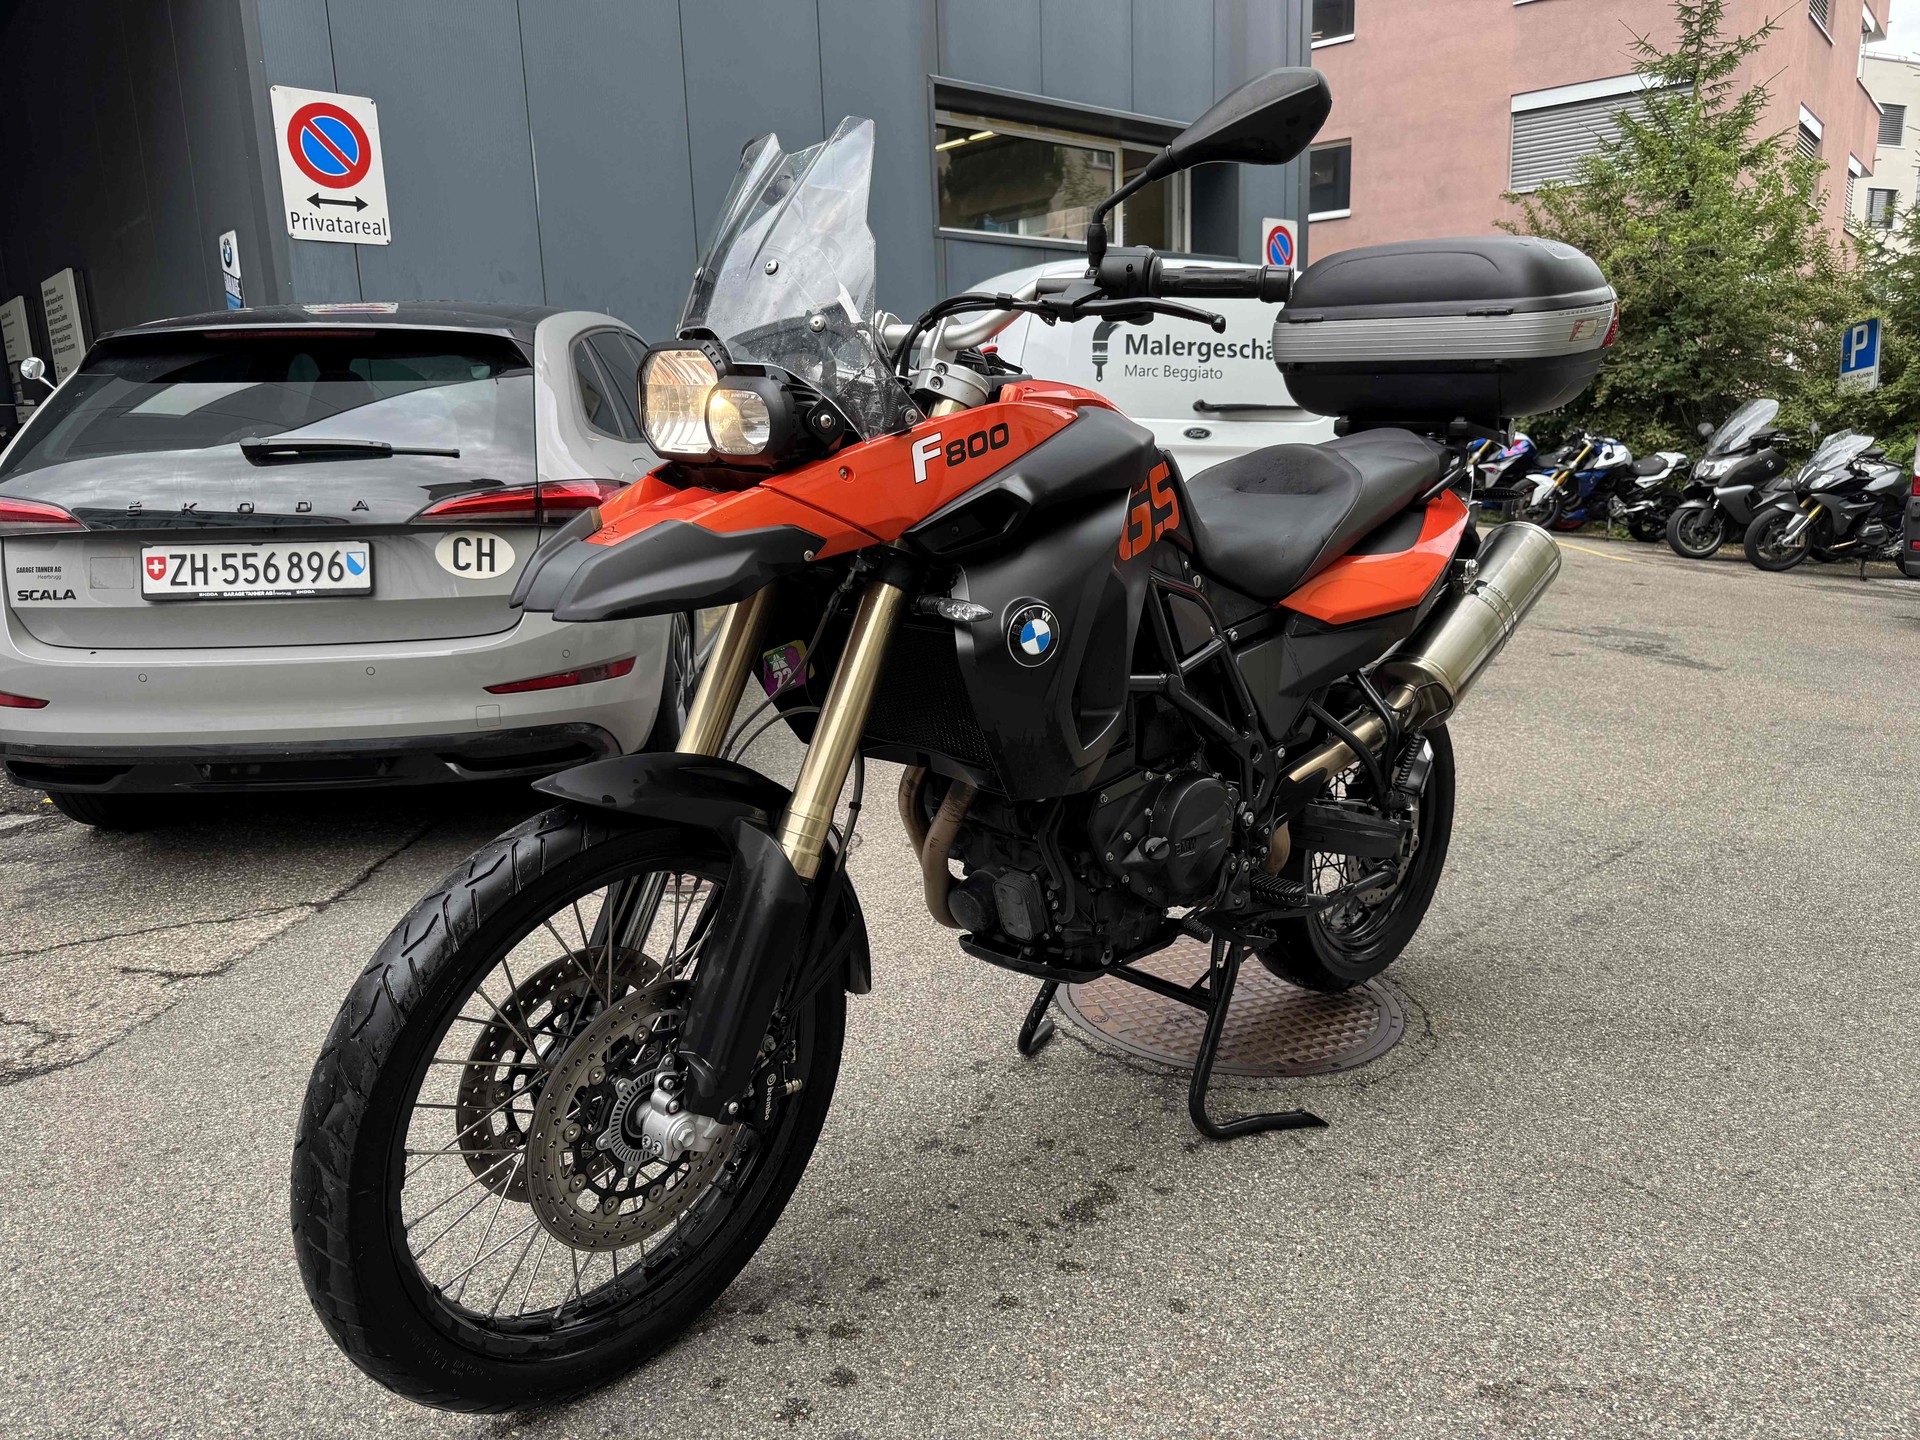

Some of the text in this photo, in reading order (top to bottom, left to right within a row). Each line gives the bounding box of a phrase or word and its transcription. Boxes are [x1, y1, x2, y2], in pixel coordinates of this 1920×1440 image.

[290, 211, 387, 237] Privatareal
[1850, 324, 1868, 369] P
[1124, 364, 1223, 382] Marc Beggiato
[1189, 428, 1206, 438] Ford
[126, 500, 370, 517] ŠKODA
[1118, 461, 1180, 561] GS
[452, 537, 496, 573] CH
[17, 589, 76, 601] SCALA
[764, 1086, 774, 1121] brembo
